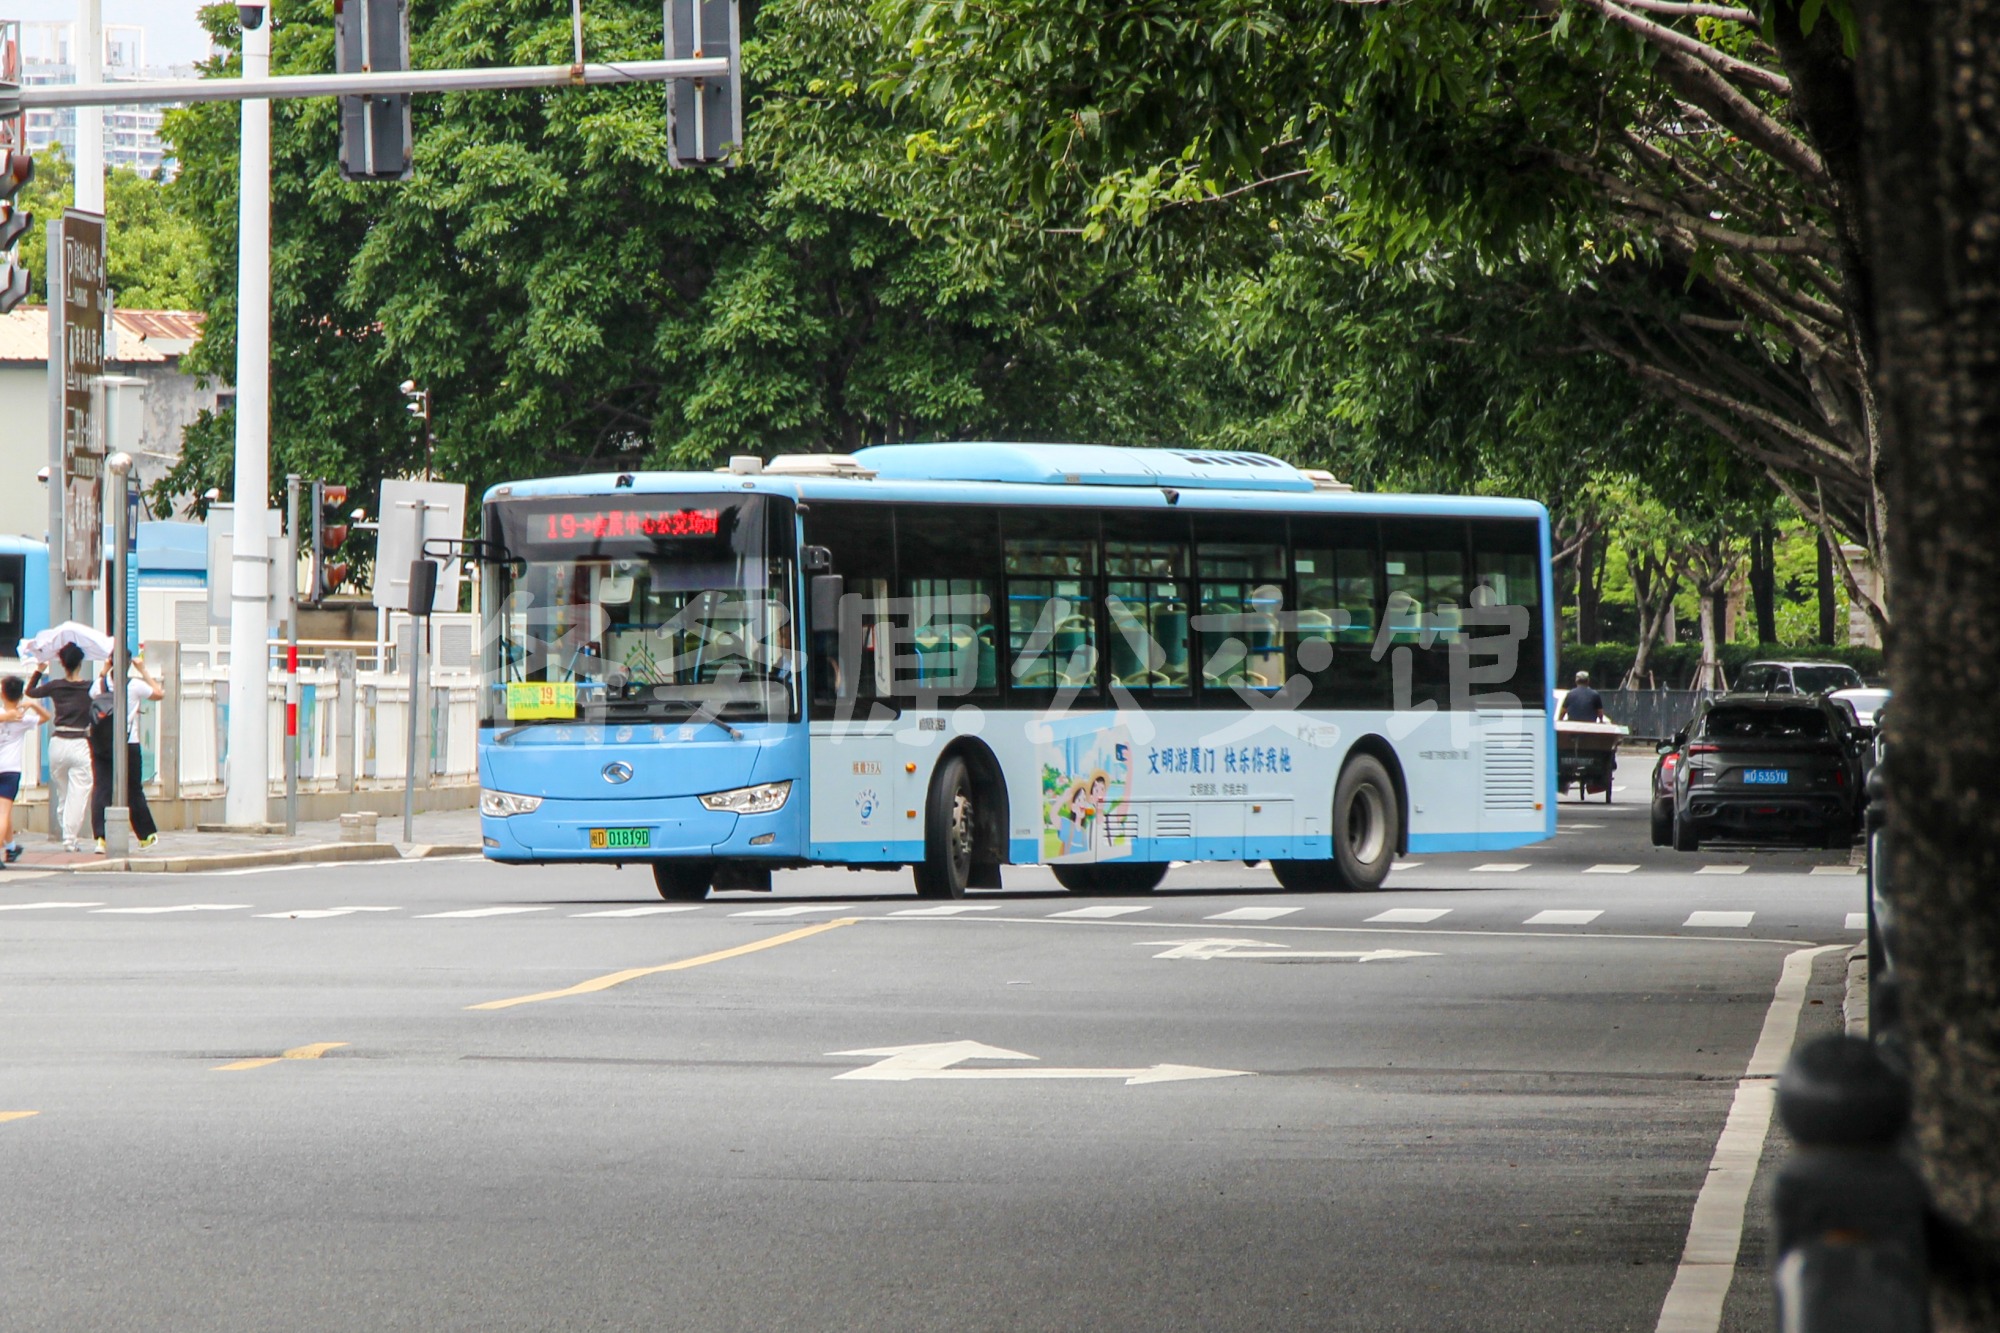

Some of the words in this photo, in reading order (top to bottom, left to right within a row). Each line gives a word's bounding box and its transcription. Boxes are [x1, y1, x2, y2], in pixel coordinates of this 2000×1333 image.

[547, 514, 576, 540] 19
[540, 686, 553, 700] 19
[1148, 746, 1216, 775] 文明游厦门
[1224, 746, 1292, 775] 快乐你我他
